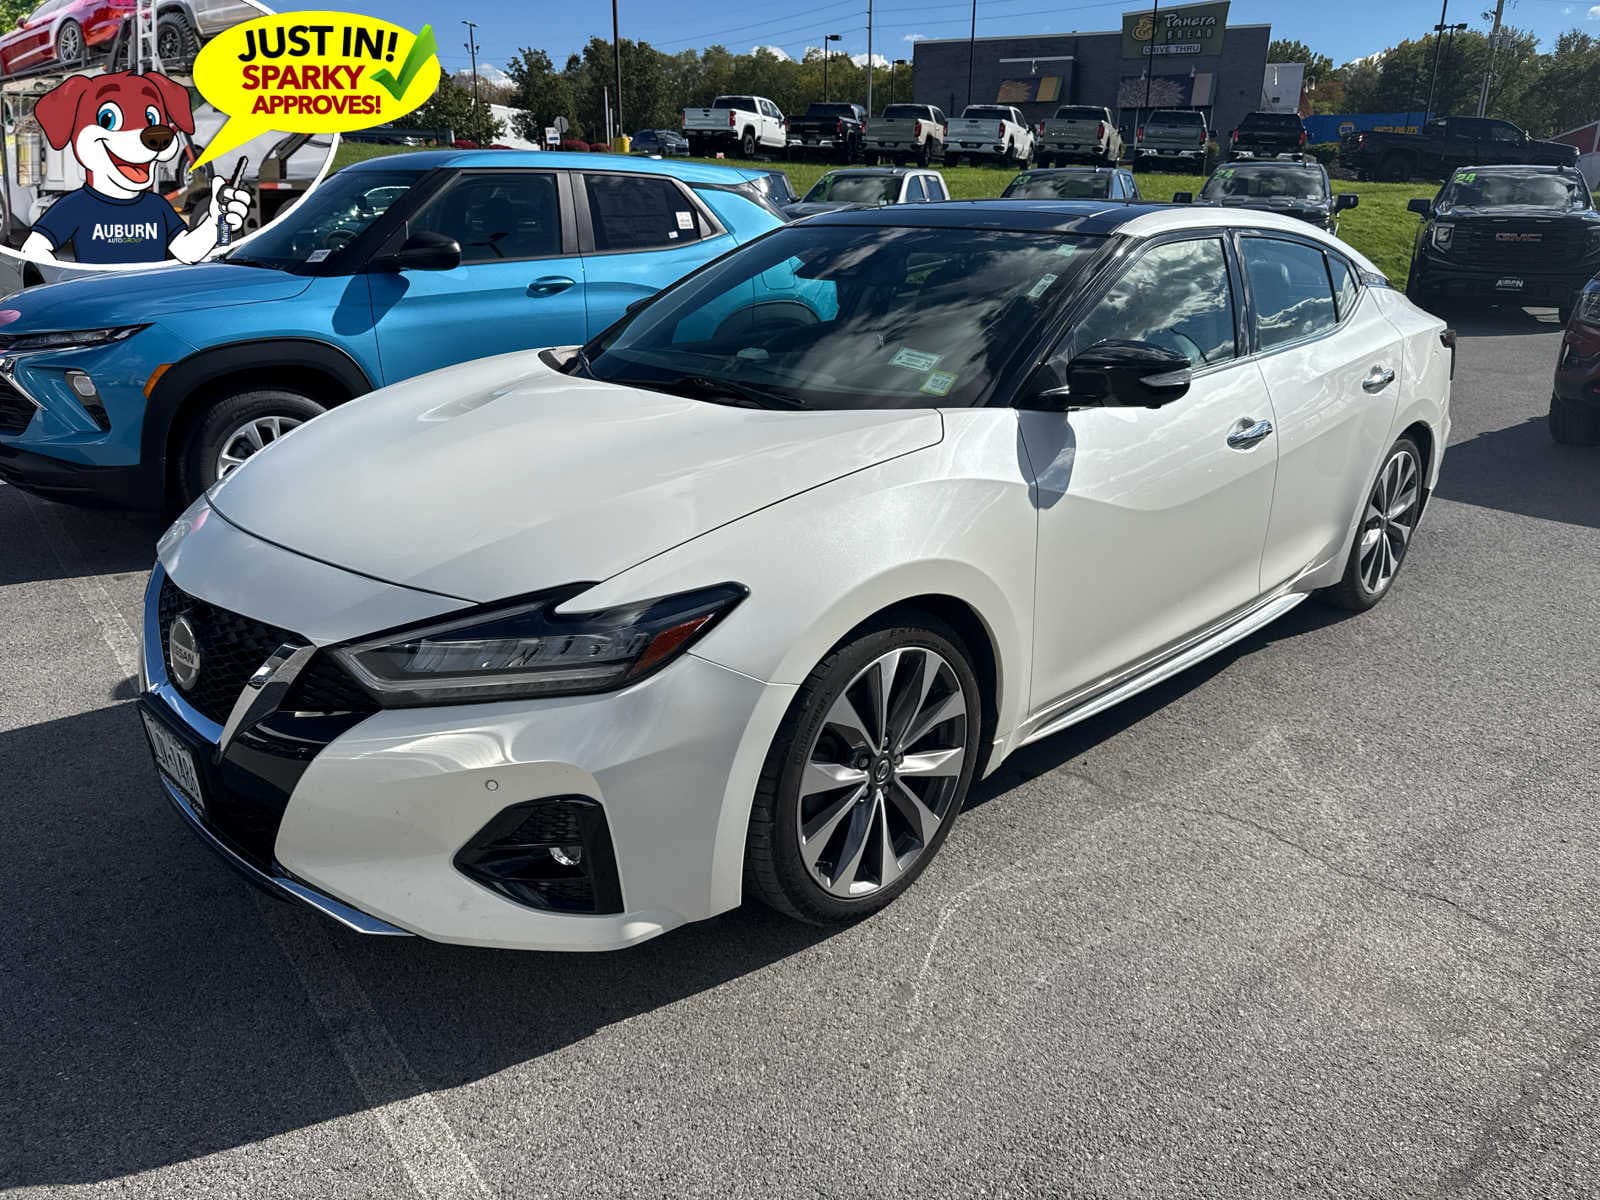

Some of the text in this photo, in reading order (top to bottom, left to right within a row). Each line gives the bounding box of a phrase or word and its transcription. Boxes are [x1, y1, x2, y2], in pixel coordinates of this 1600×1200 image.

[1164, 13, 1216, 27] Panera
[1174, 45, 1199, 53] THRU
[1454, 173, 1477, 183] 24
[1495, 232, 1543, 242] GMC
